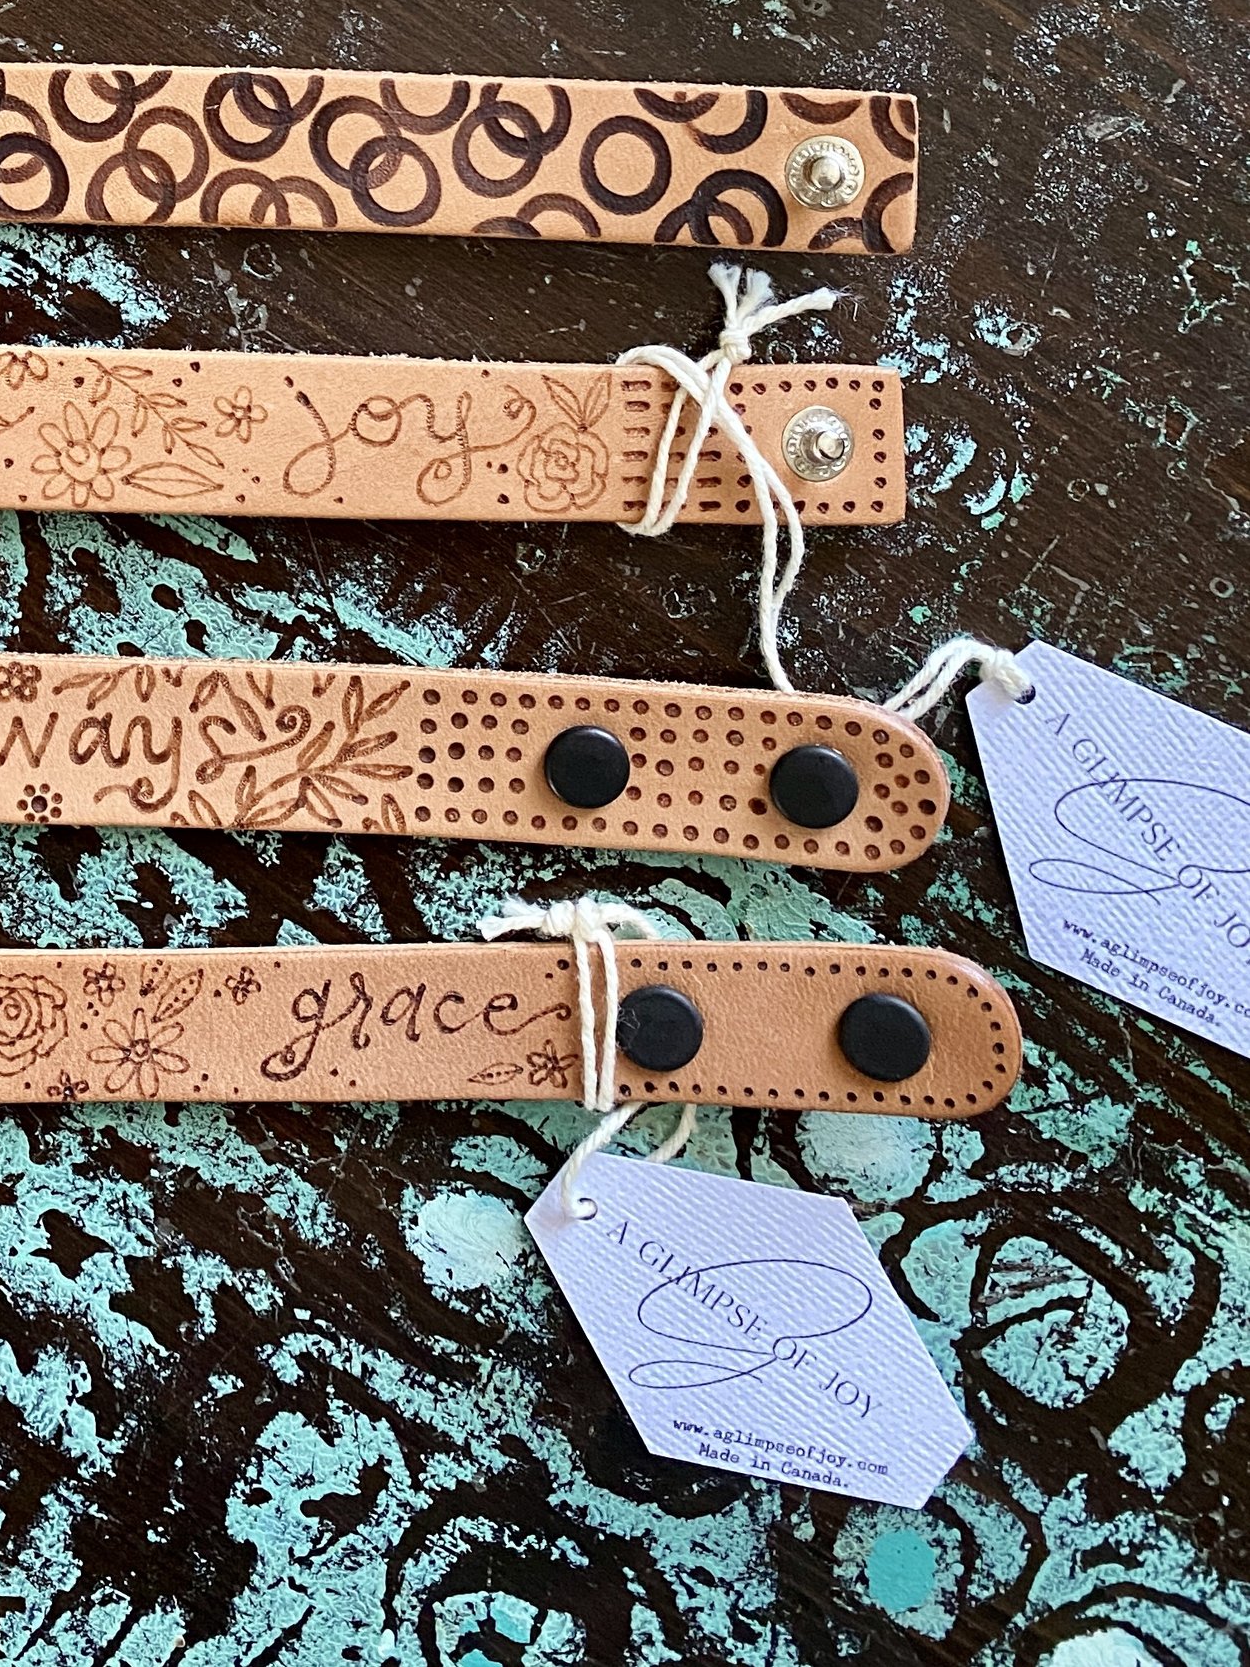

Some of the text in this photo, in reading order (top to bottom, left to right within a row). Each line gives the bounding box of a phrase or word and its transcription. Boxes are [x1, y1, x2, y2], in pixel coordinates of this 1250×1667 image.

[282, 376, 537, 506] joy
[1045, 713, 1250, 962] A GLIMPSE OF JO
[260, 971, 572, 1082] grace
[1080, 948, 1222, 1027] Made in Canada.
[606, 1221, 883, 1418] A GLIMPSE OF JOY
[672, 1419, 889, 1476] www.aglimpseofjoy.com
[699, 1442, 849, 1488] Made in Canada.
